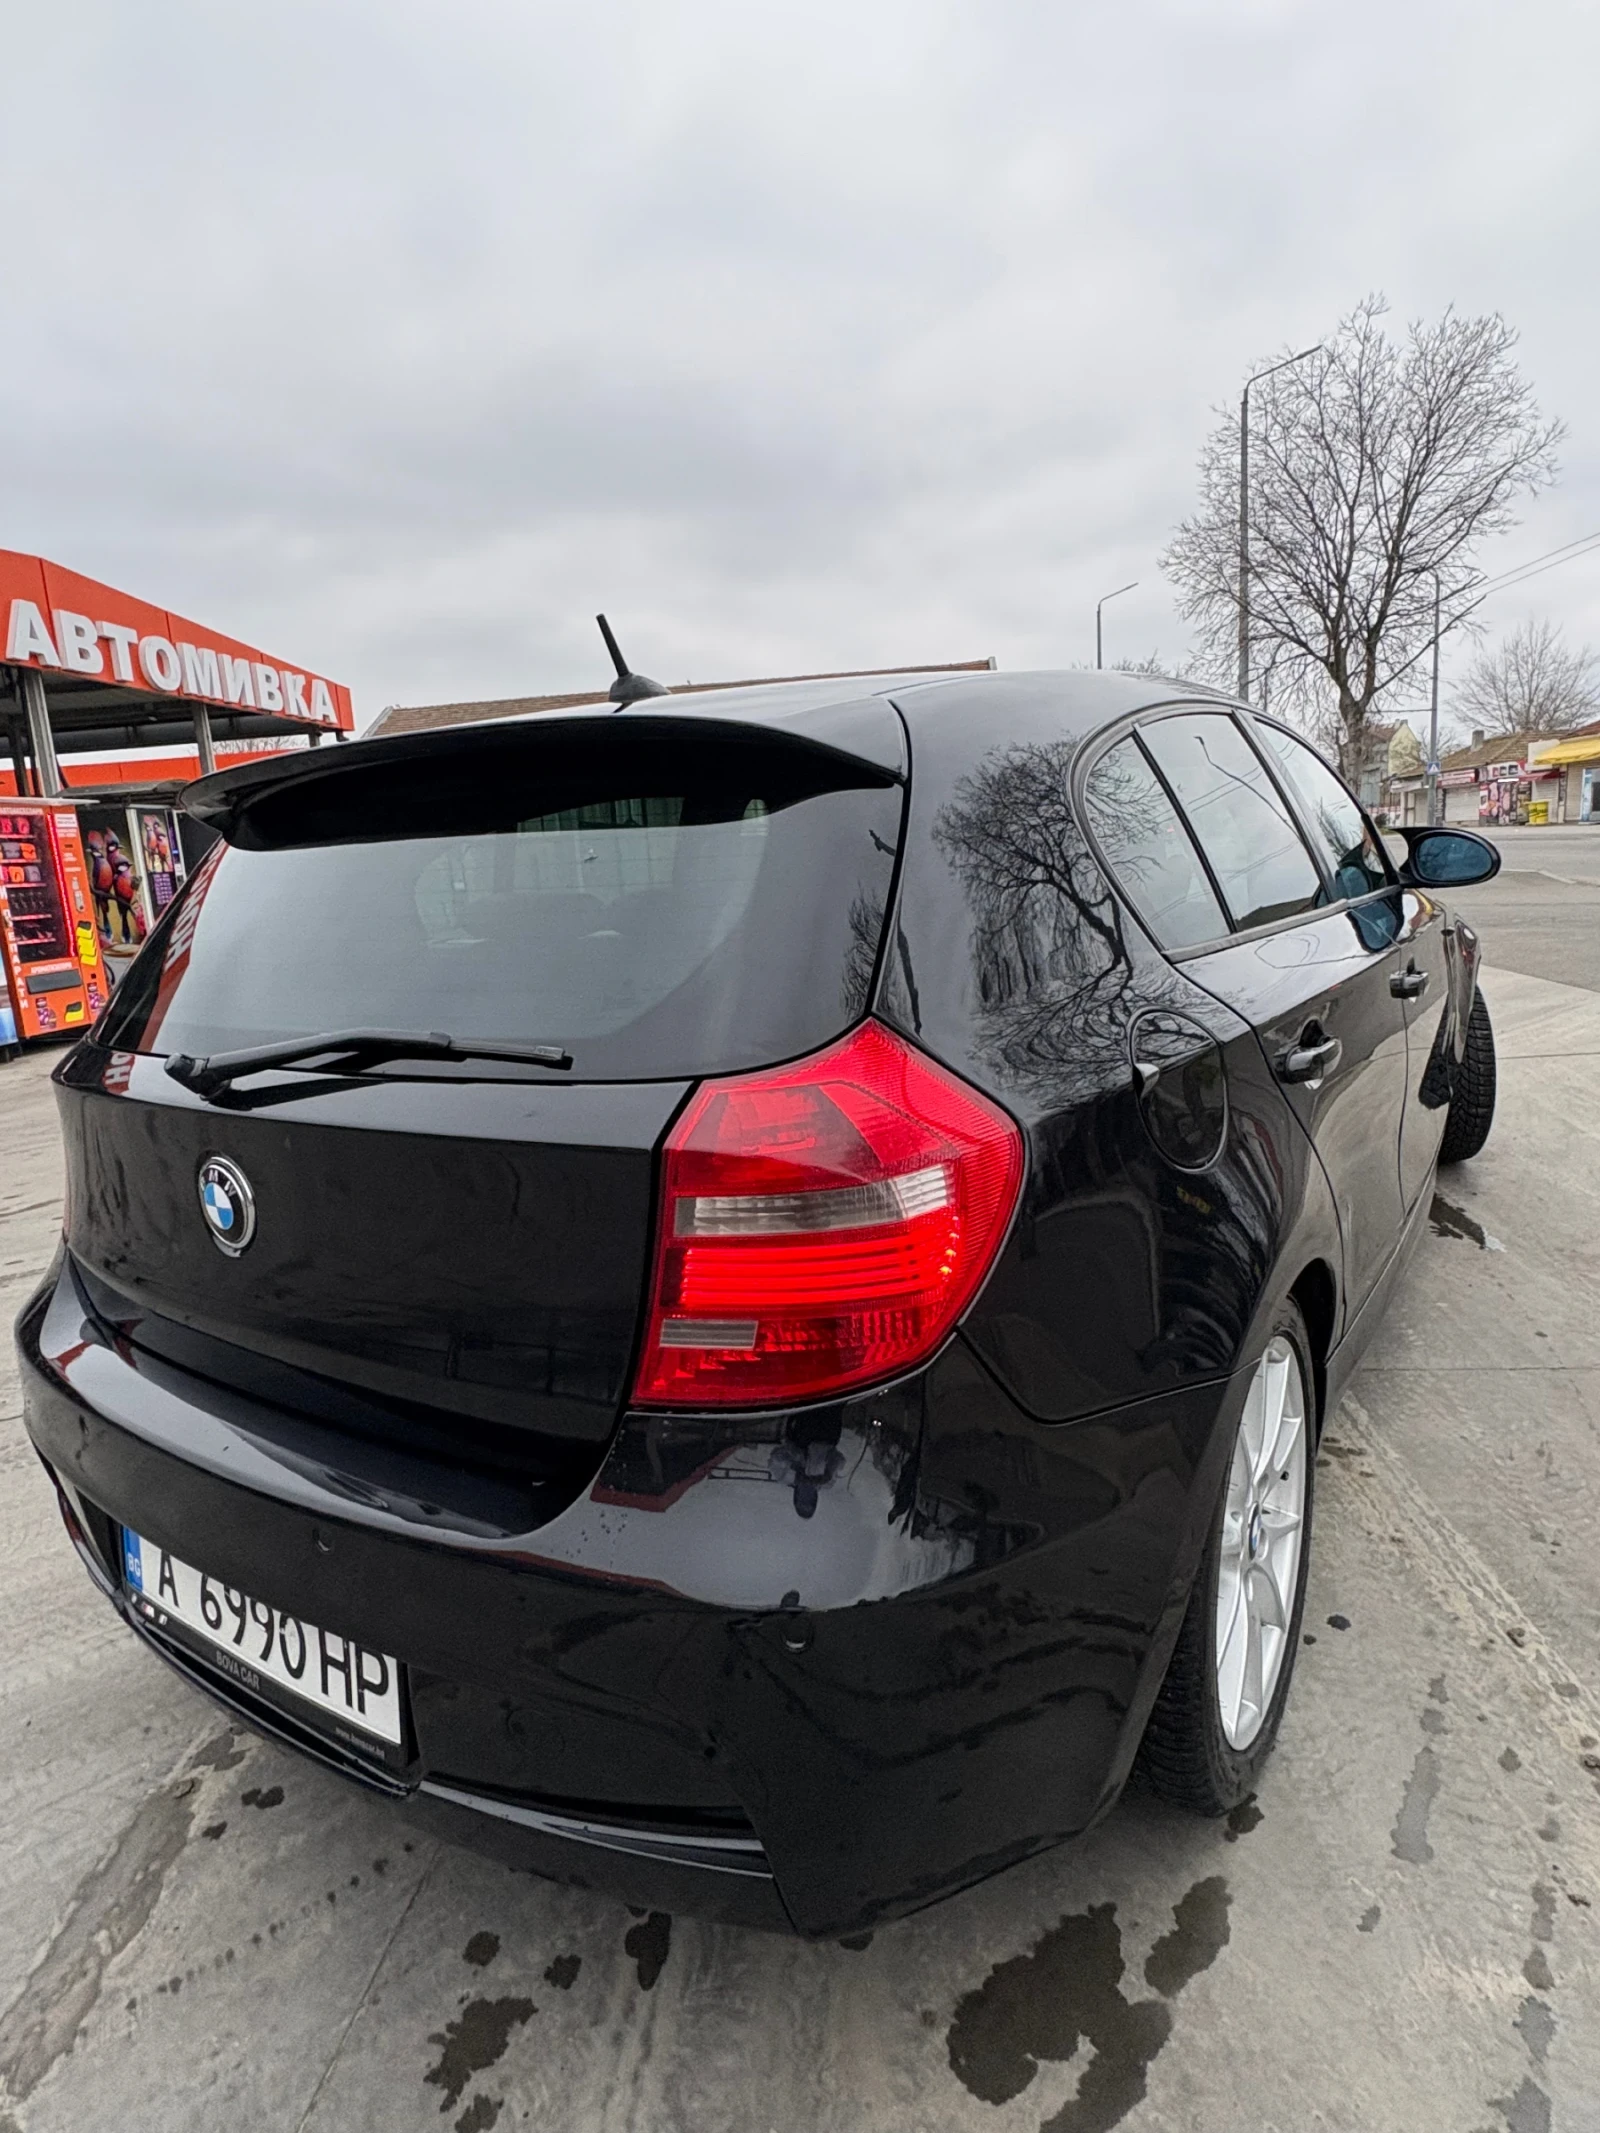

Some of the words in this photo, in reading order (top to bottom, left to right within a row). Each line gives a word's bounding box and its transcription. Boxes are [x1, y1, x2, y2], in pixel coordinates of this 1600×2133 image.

[6, 599, 338, 723] АВТОМИВКА
[127, 1552, 141, 1577] BG
[200, 1573, 306, 1679] 6990
